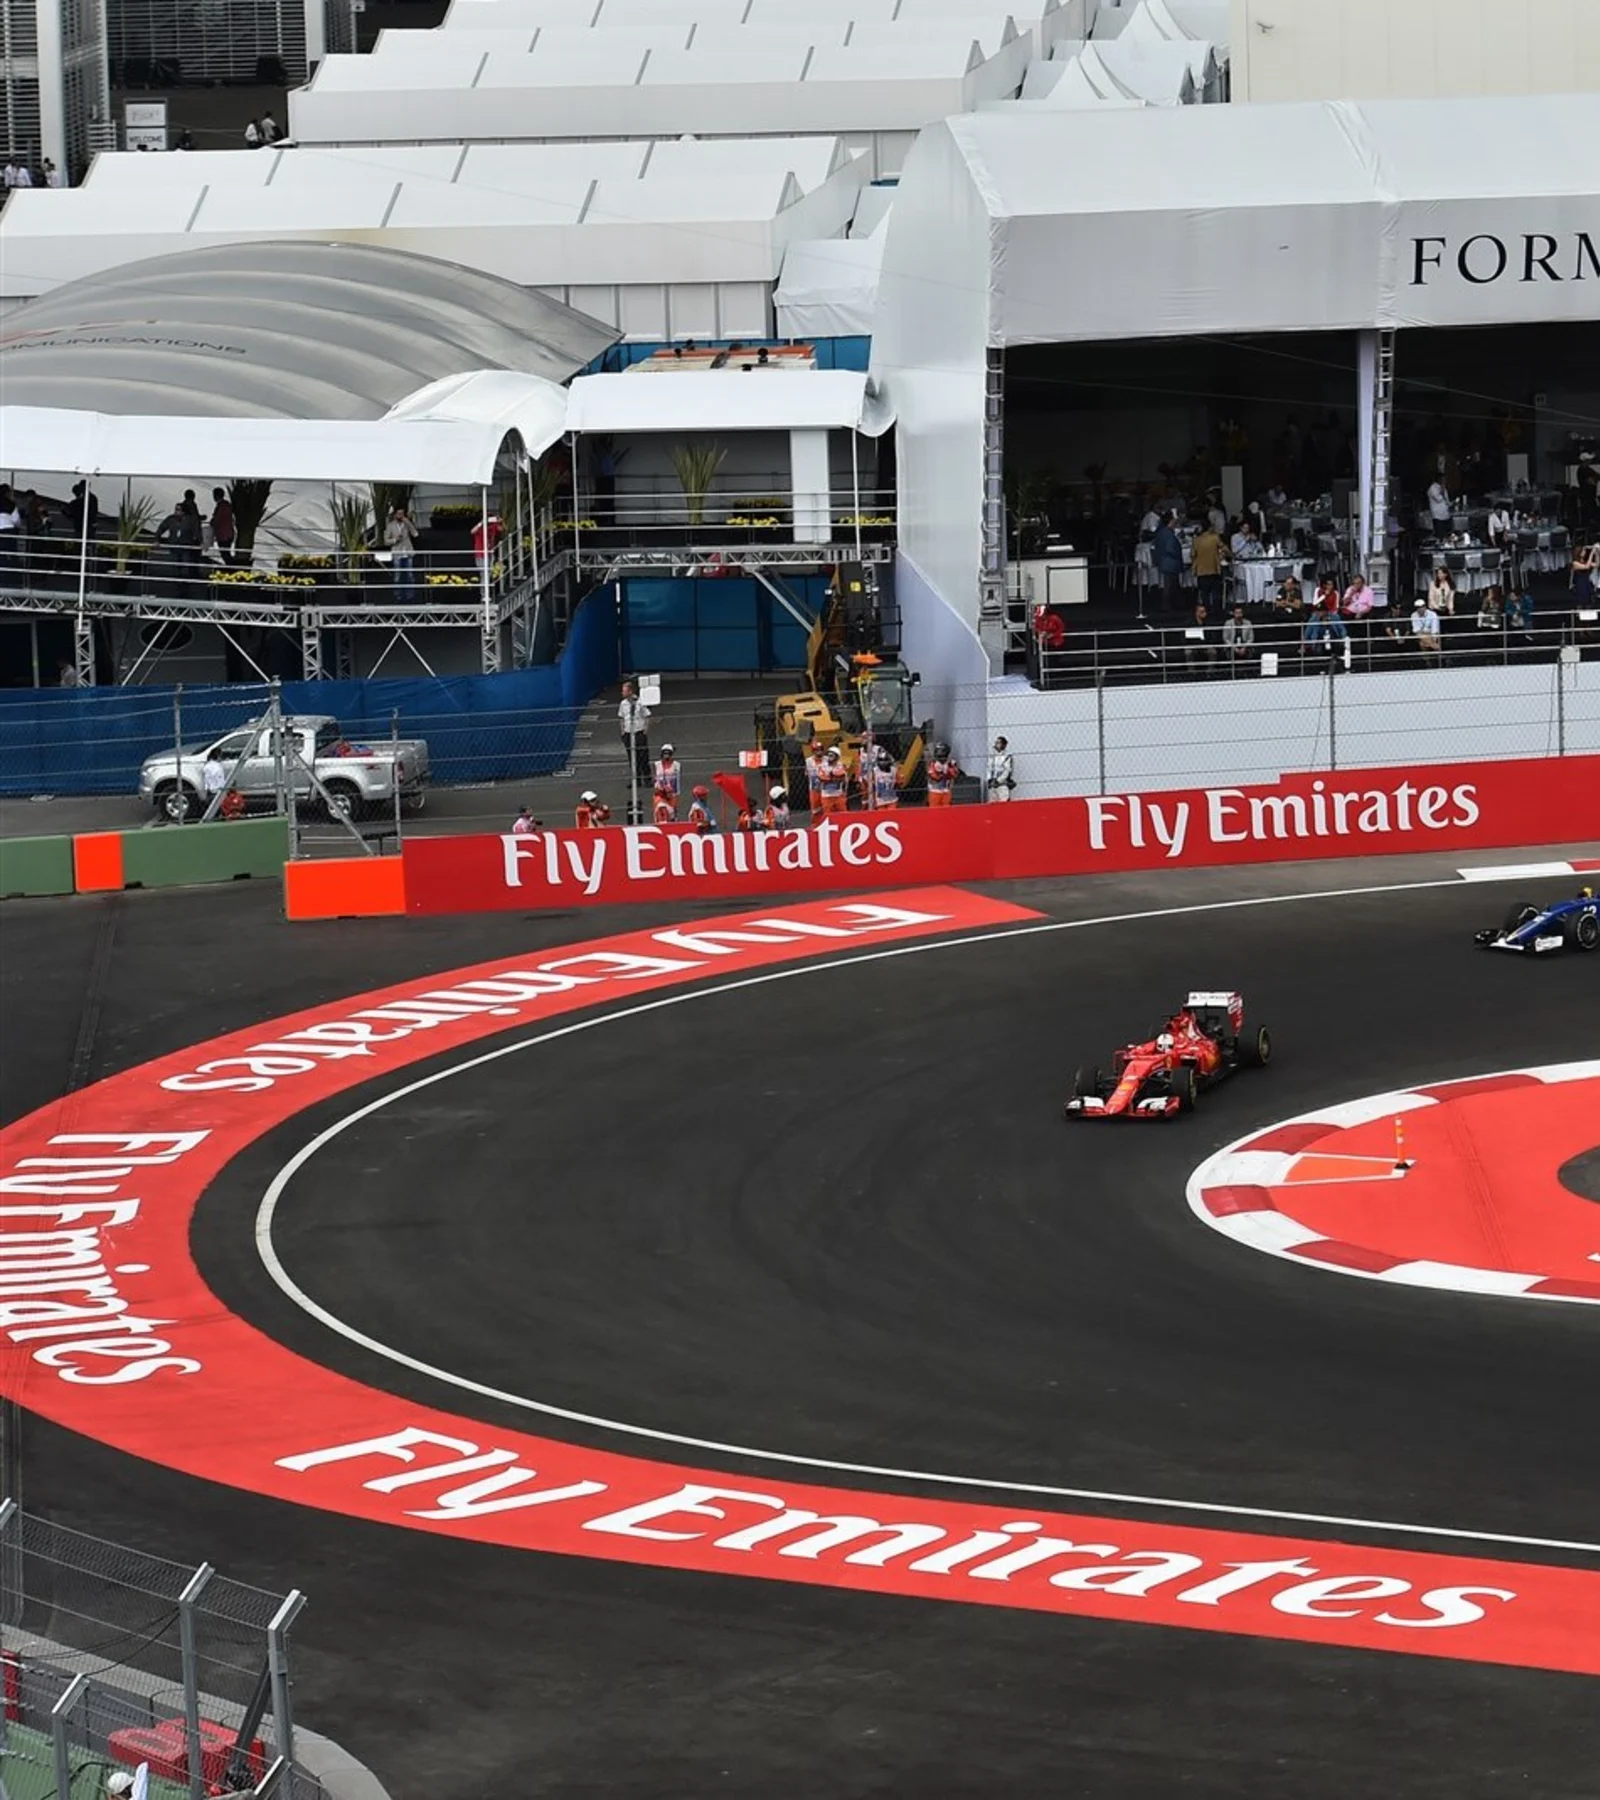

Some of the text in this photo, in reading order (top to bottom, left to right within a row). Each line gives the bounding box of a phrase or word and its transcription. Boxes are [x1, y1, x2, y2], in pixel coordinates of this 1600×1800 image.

[500, 816, 903, 894] Fly Emirates
[1085, 780, 1479, 857] Fly Emirates
[159, 903, 953, 1092] Fly Emirates
[0, 1129, 213, 1385] Fly Emirates
[274, 1426, 1517, 1628] Fly Emirates
